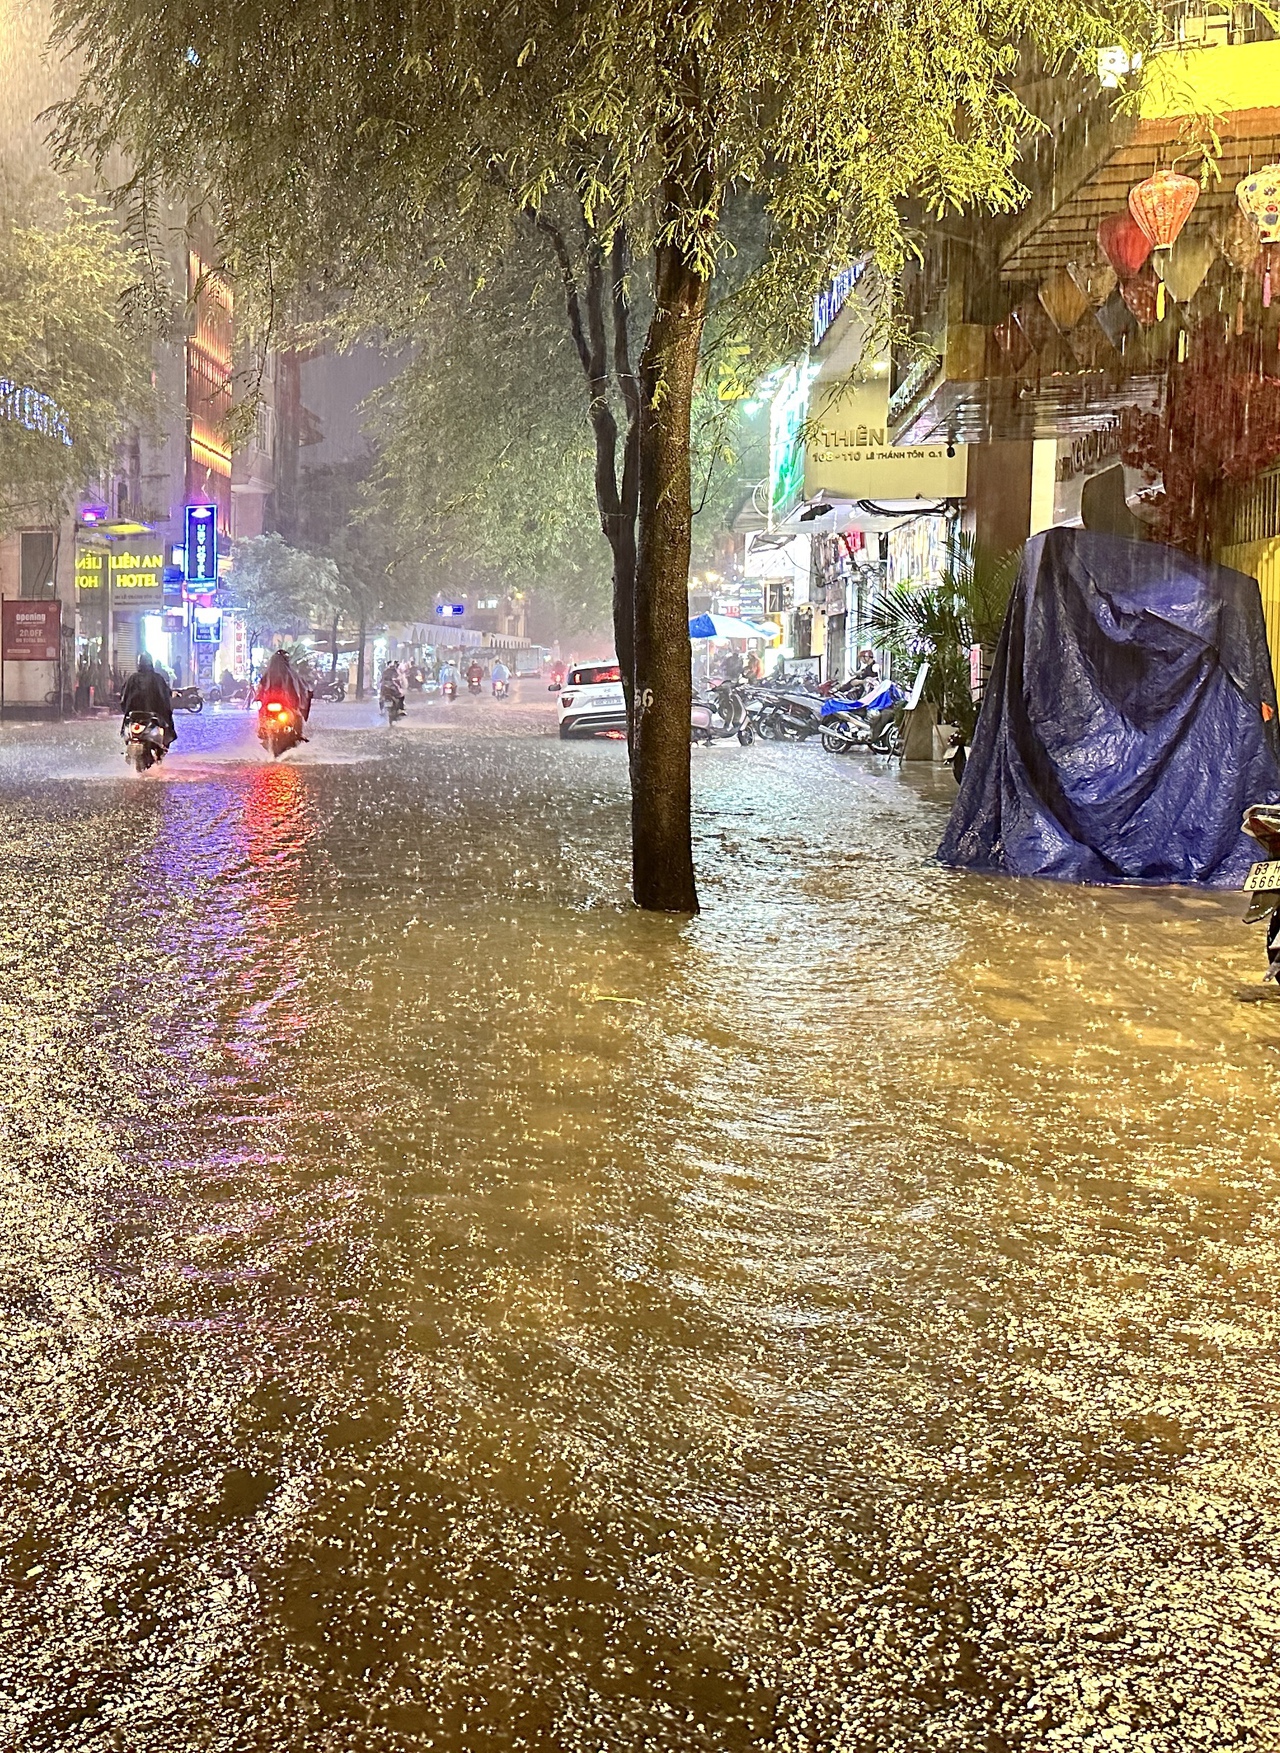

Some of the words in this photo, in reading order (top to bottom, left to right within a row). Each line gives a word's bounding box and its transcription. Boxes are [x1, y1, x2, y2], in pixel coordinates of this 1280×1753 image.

[111, 552, 140, 569] LIÊN
[141, 554, 163, 568] AN
[116, 573, 158, 588] HOTEL
[16, 612, 46, 622] opening
